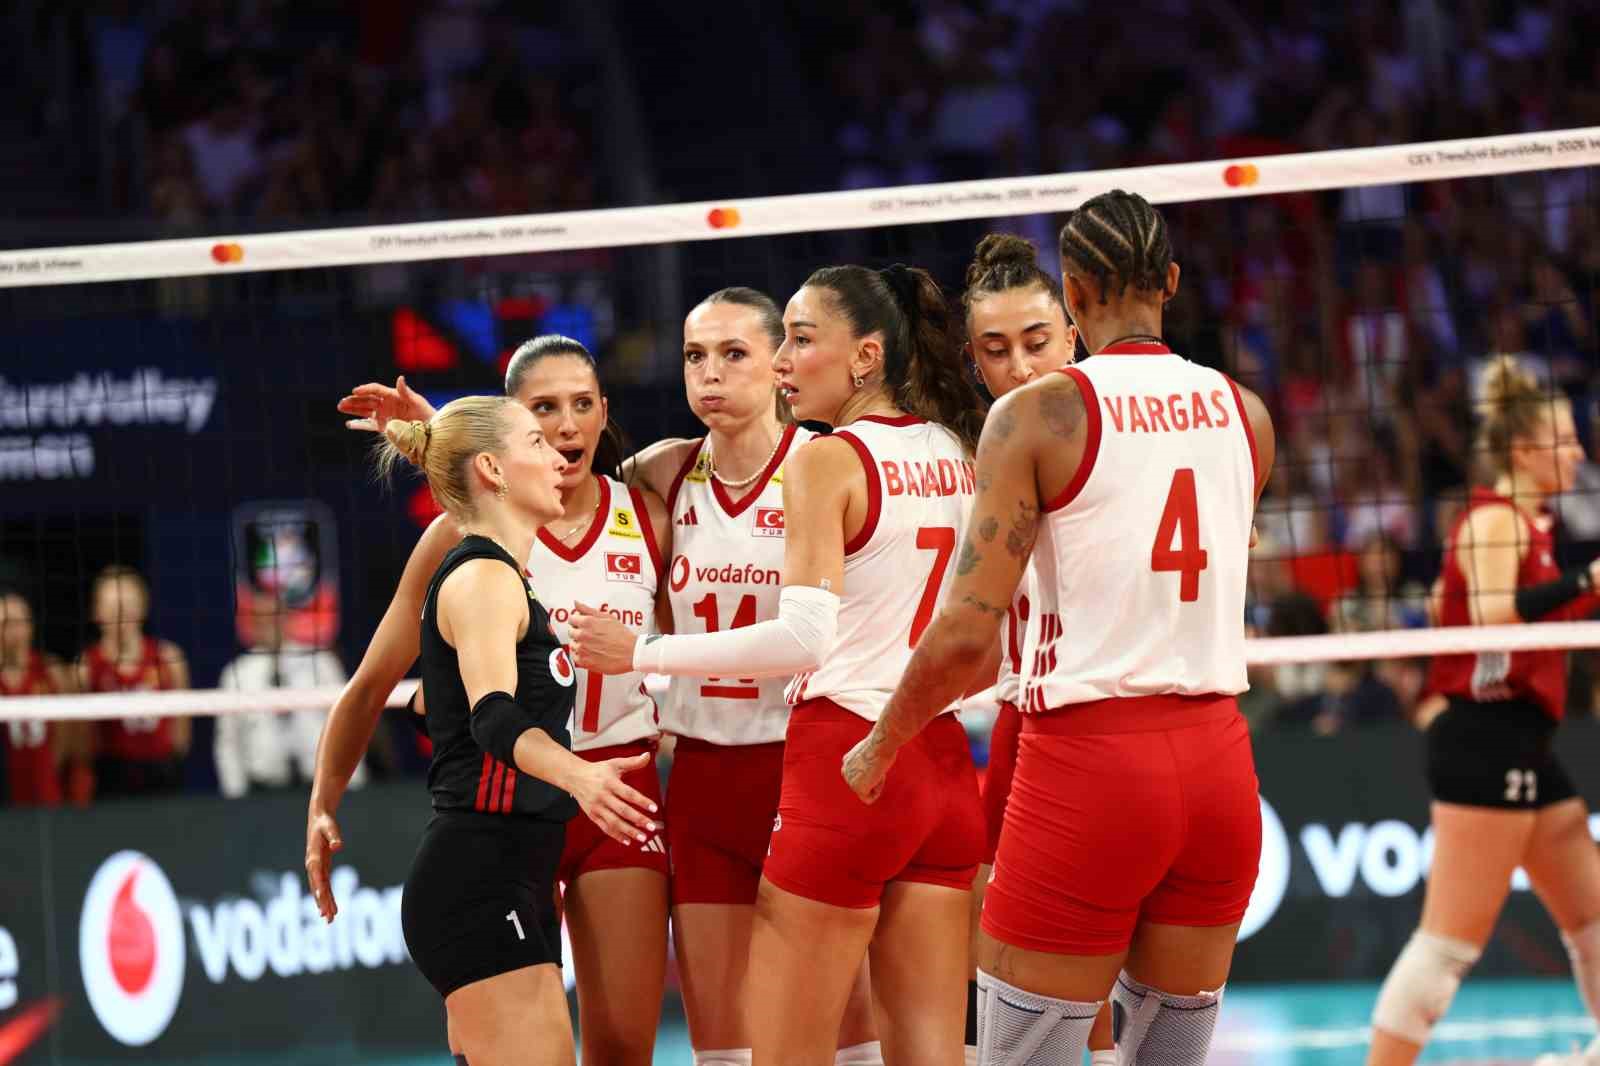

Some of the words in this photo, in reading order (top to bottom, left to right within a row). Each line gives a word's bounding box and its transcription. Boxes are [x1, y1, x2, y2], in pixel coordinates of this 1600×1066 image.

[0, 366, 216, 435] uroVolley
[1103, 390, 1230, 433] VARGAS
[617, 512, 629, 526] S
[1151, 468, 1207, 602] 4
[696, 563, 781, 585] vodafon
[908, 527, 956, 650] 7
[506, 910, 526, 940] 1
